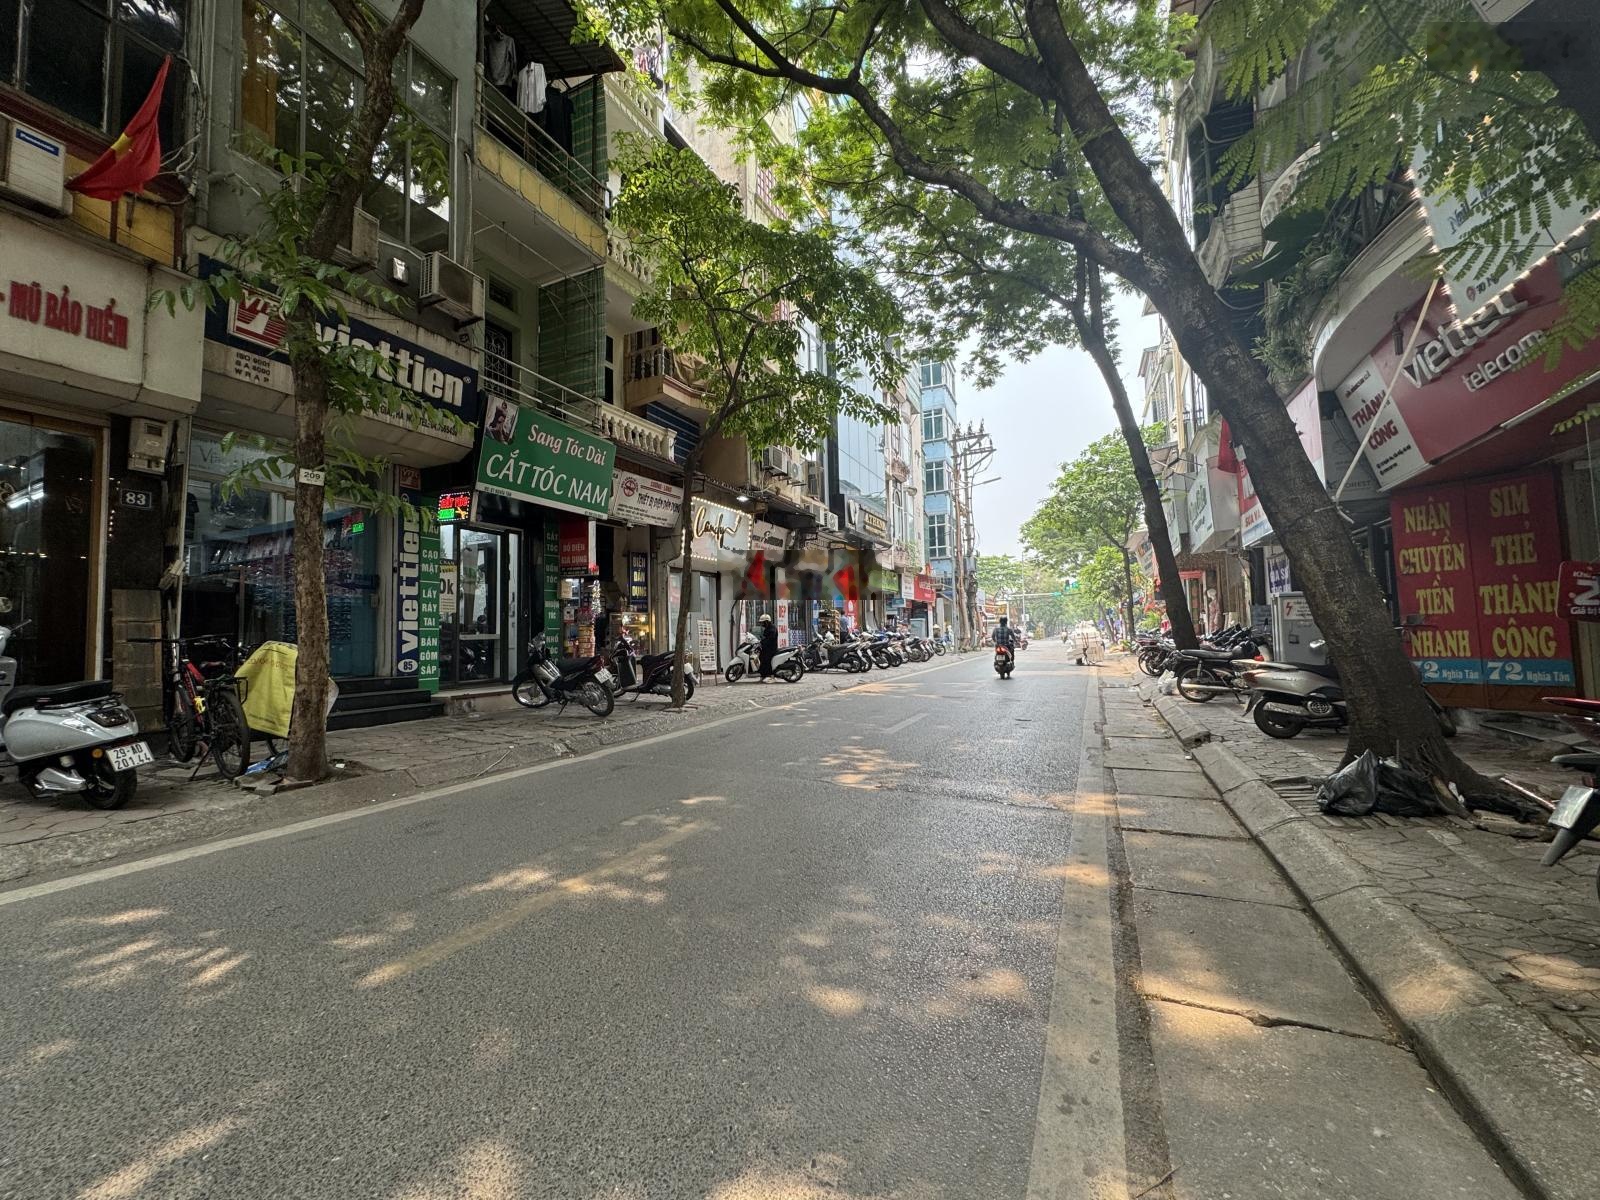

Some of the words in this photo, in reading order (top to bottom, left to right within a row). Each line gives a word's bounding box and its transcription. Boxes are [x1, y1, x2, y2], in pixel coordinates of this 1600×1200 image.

[8, 280, 42, 325] MŨ
[44, 284, 83, 336] BẢO
[85, 297, 129, 350] HIỂM
[1352, 389, 1390, 428] THÀN
[527, 423, 563, 454] Sang
[564, 437, 585, 459] Tóc
[585, 446, 606, 466] Dài
[486, 449, 531, 485] CẮT
[531, 464, 567, 495] TÓC
[567, 478, 608, 507] NAM
[125, 491, 146, 505] 83
[1403, 496, 1450, 536] NHẬN
[1489, 483, 1529, 517] SIM
[422, 549, 438, 561] CẠO
[1491, 521, 1538, 565] THẺ
[1415, 574, 1455, 615] TIỀN
[1479, 574, 1557, 615] THÀNH
[423, 616, 435, 626] TAI
[1491, 617, 1557, 658] CÔNG
[1411, 630, 1471, 658] NHANH
[403, 660, 413, 671] 85
[420, 662, 437, 675] SÁP
[1487, 661, 1523, 681] 72
[1526, 671, 1551, 683] Nghĩa
[1552, 671, 1570, 682] Tân
